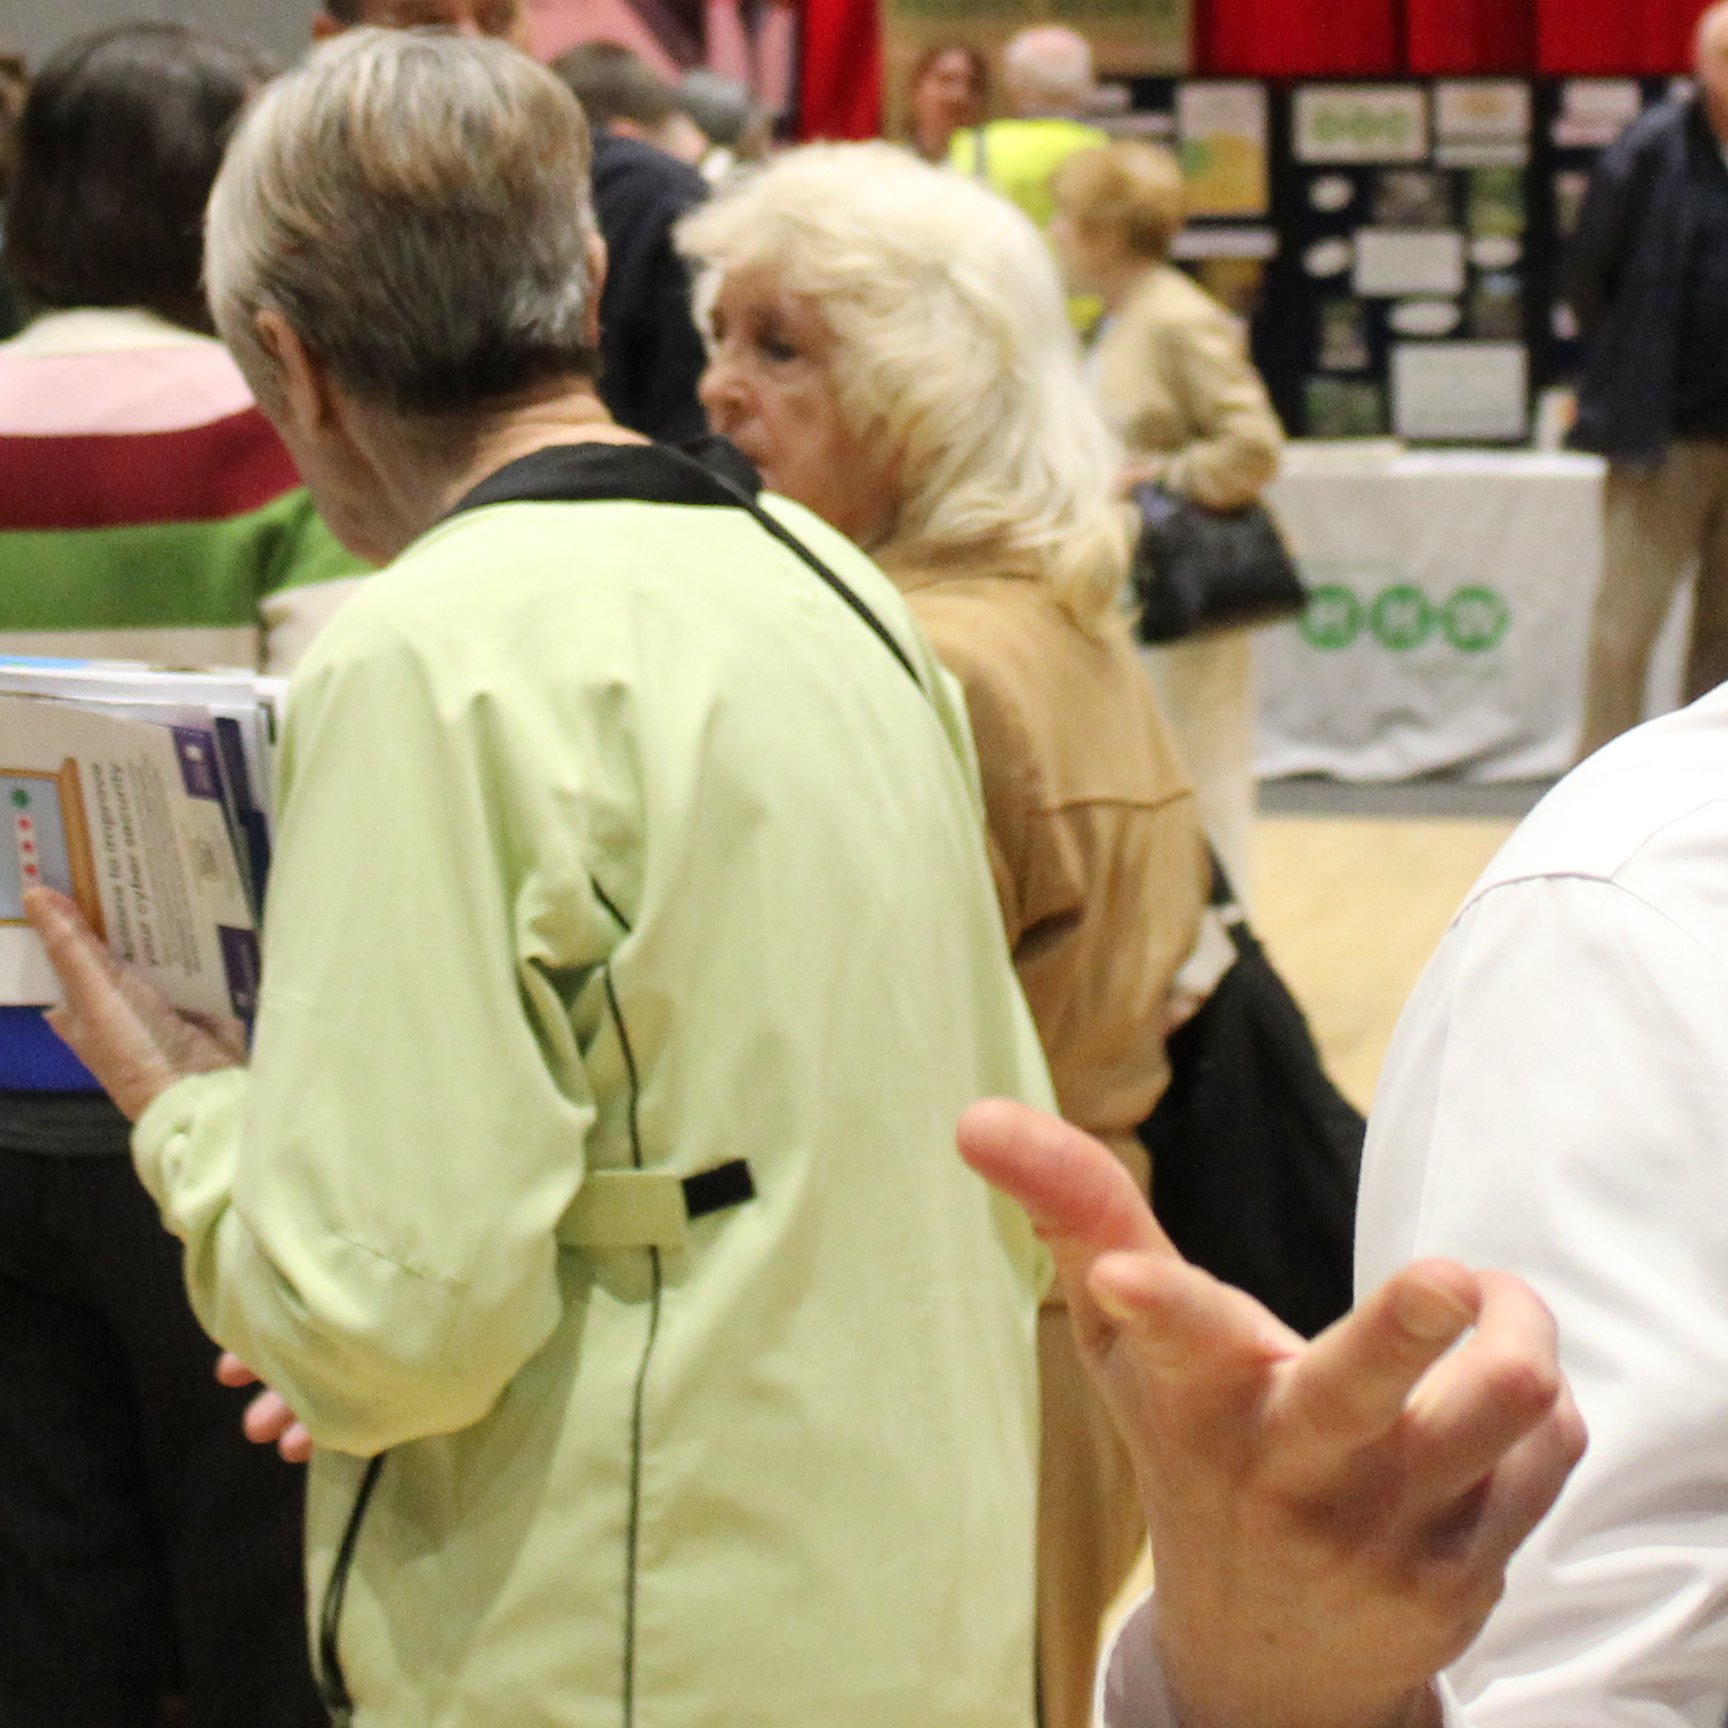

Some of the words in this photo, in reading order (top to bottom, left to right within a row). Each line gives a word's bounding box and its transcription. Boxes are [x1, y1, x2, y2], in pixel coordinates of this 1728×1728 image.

[91, 761, 114, 853] improve
[109, 759, 136, 848] security
[108, 857, 121, 879] to
[128, 854, 148, 915] cyber
[113, 885, 135, 963] Actions
[139, 922, 161, 967] your
